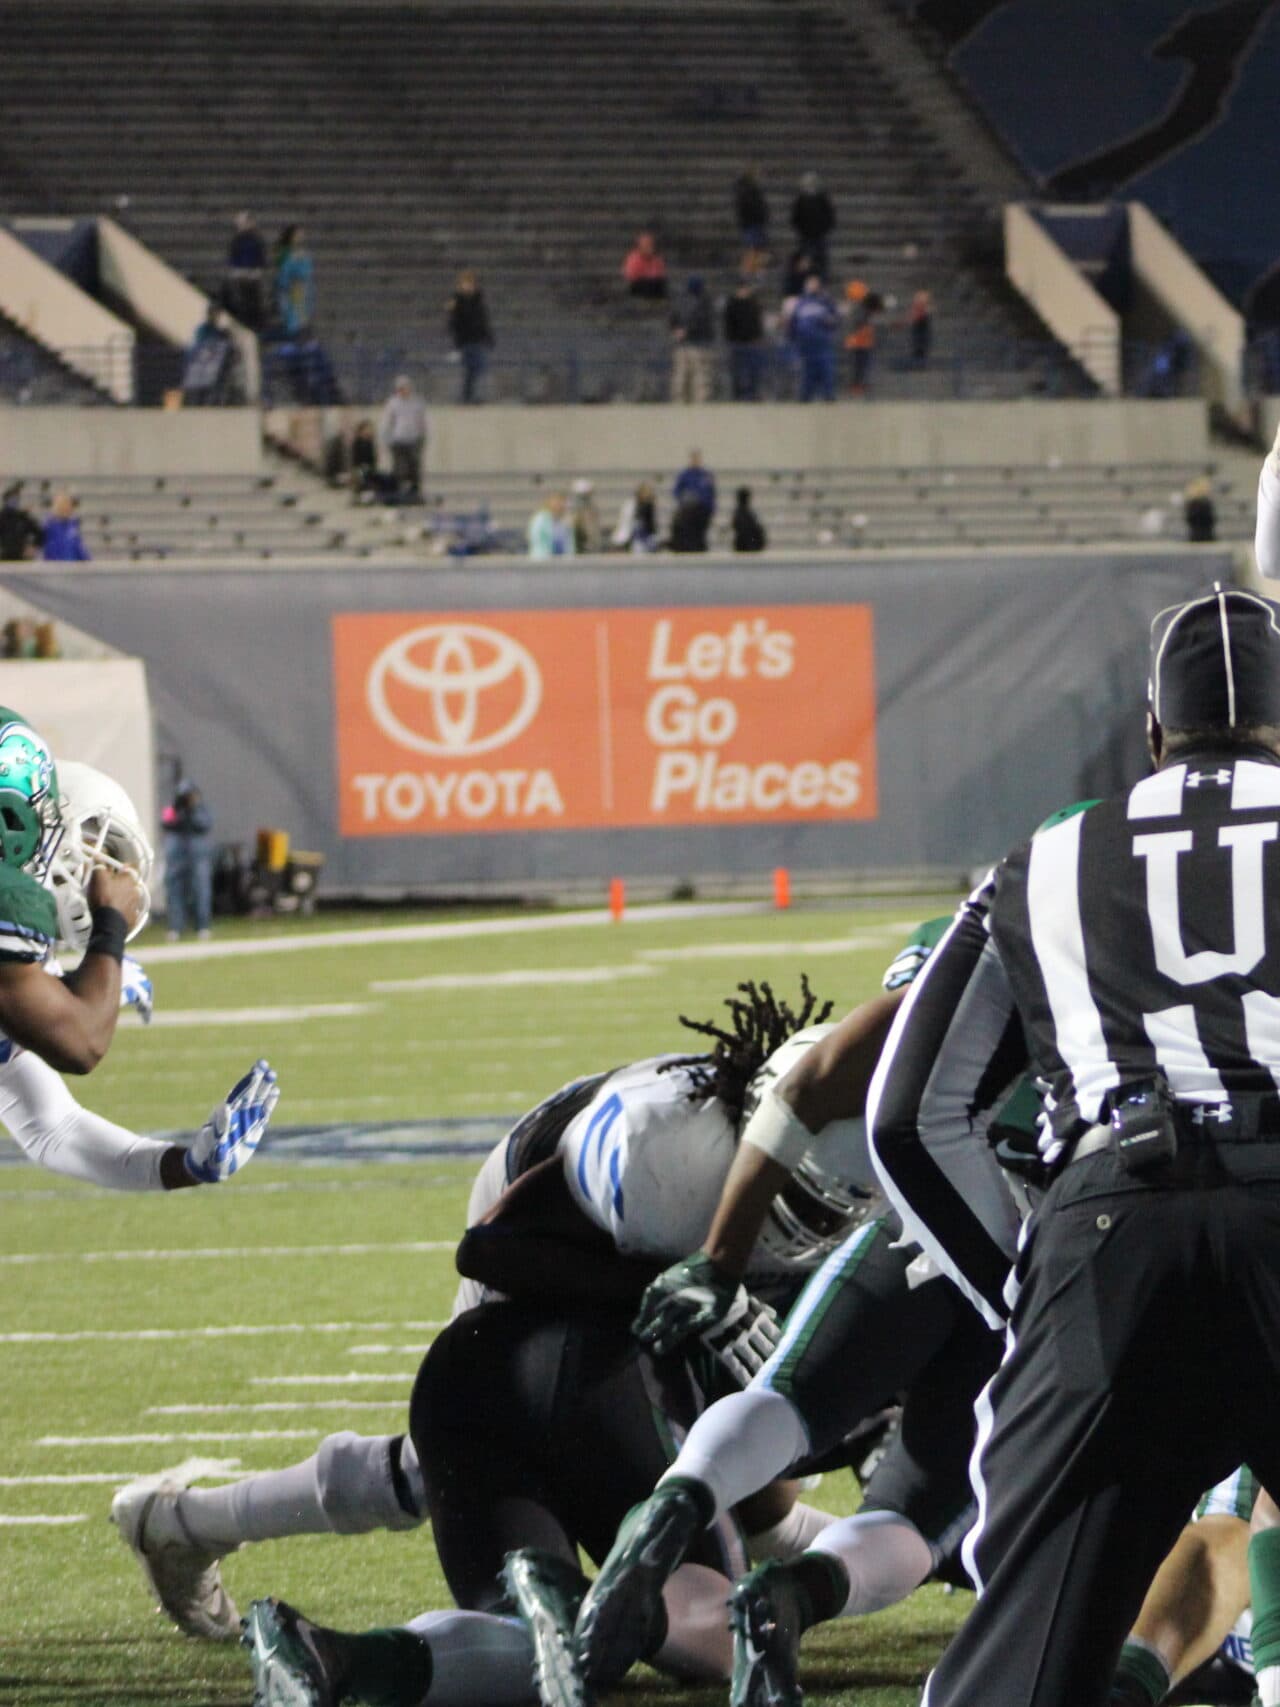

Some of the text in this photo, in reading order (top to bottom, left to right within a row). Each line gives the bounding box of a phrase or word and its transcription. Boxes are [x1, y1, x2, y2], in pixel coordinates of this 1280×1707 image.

[648, 619, 795, 680] Let's
[645, 684, 738, 746] Go
[352, 769, 565, 821] TOYOTA
[651, 749, 862, 814] Places
[1133, 820, 1279, 985] U
